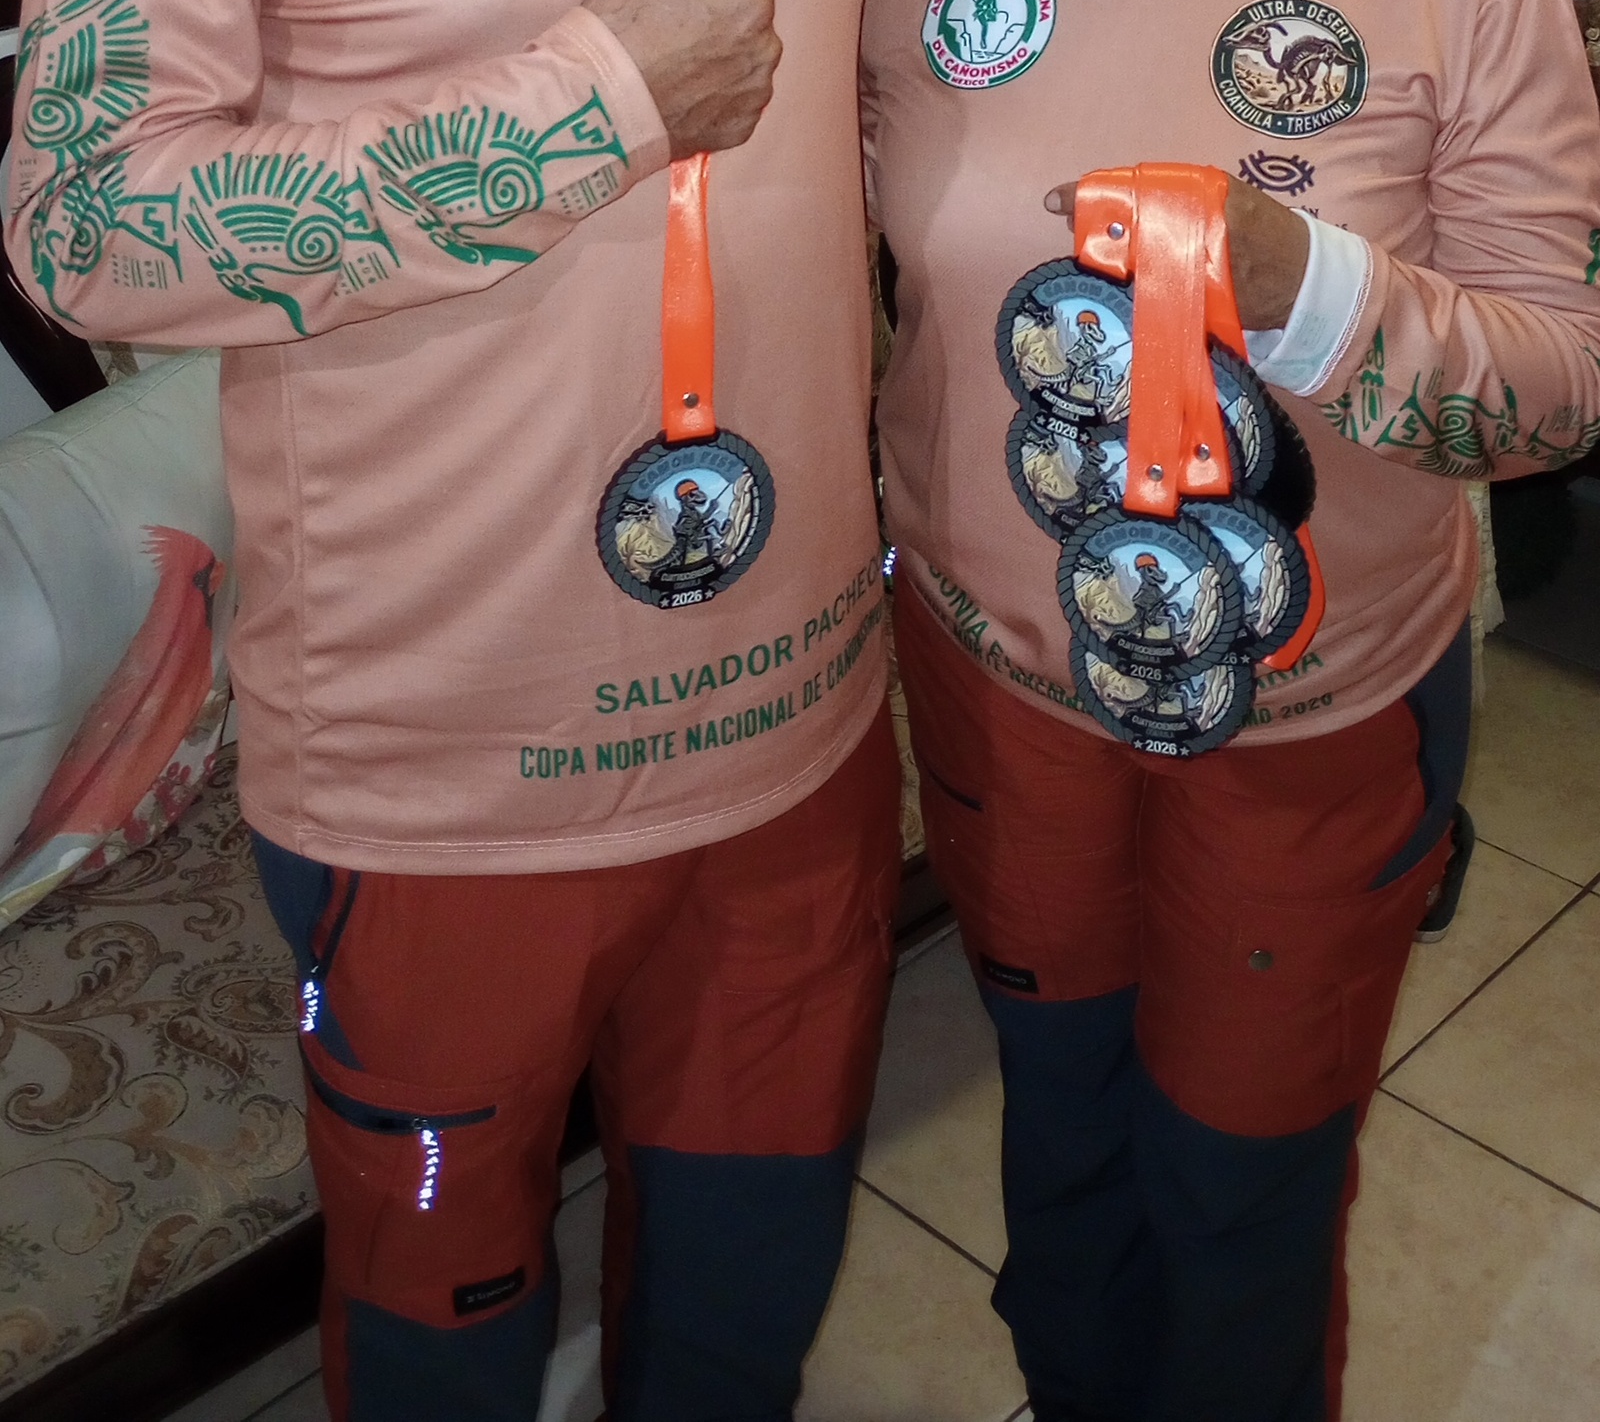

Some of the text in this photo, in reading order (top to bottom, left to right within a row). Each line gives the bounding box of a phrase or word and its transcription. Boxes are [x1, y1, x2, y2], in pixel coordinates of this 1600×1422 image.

[1248, 0, 1355, 44] ULTRA DESERT
[932, 39, 1027, 78] DE CAÑONISMO
[951, 77, 985, 86] MEXICO
[1219, 79, 1352, 133] COAHUILA TREKKING
[1046, 417, 1078, 439] 2026
[672, 589, 703, 606] 2026
[1222, 652, 1238, 665] 26
[595, 634, 795, 715] SALVADOR
[1130, 664, 1162, 681] 2026
[520, 746, 586, 779] COPA
[596, 731, 677, 771] NORTE
[686, 690, 797, 754] NACIONAL
[803, 671, 822, 710] DE
[1145, 739, 1178, 756] 2026
